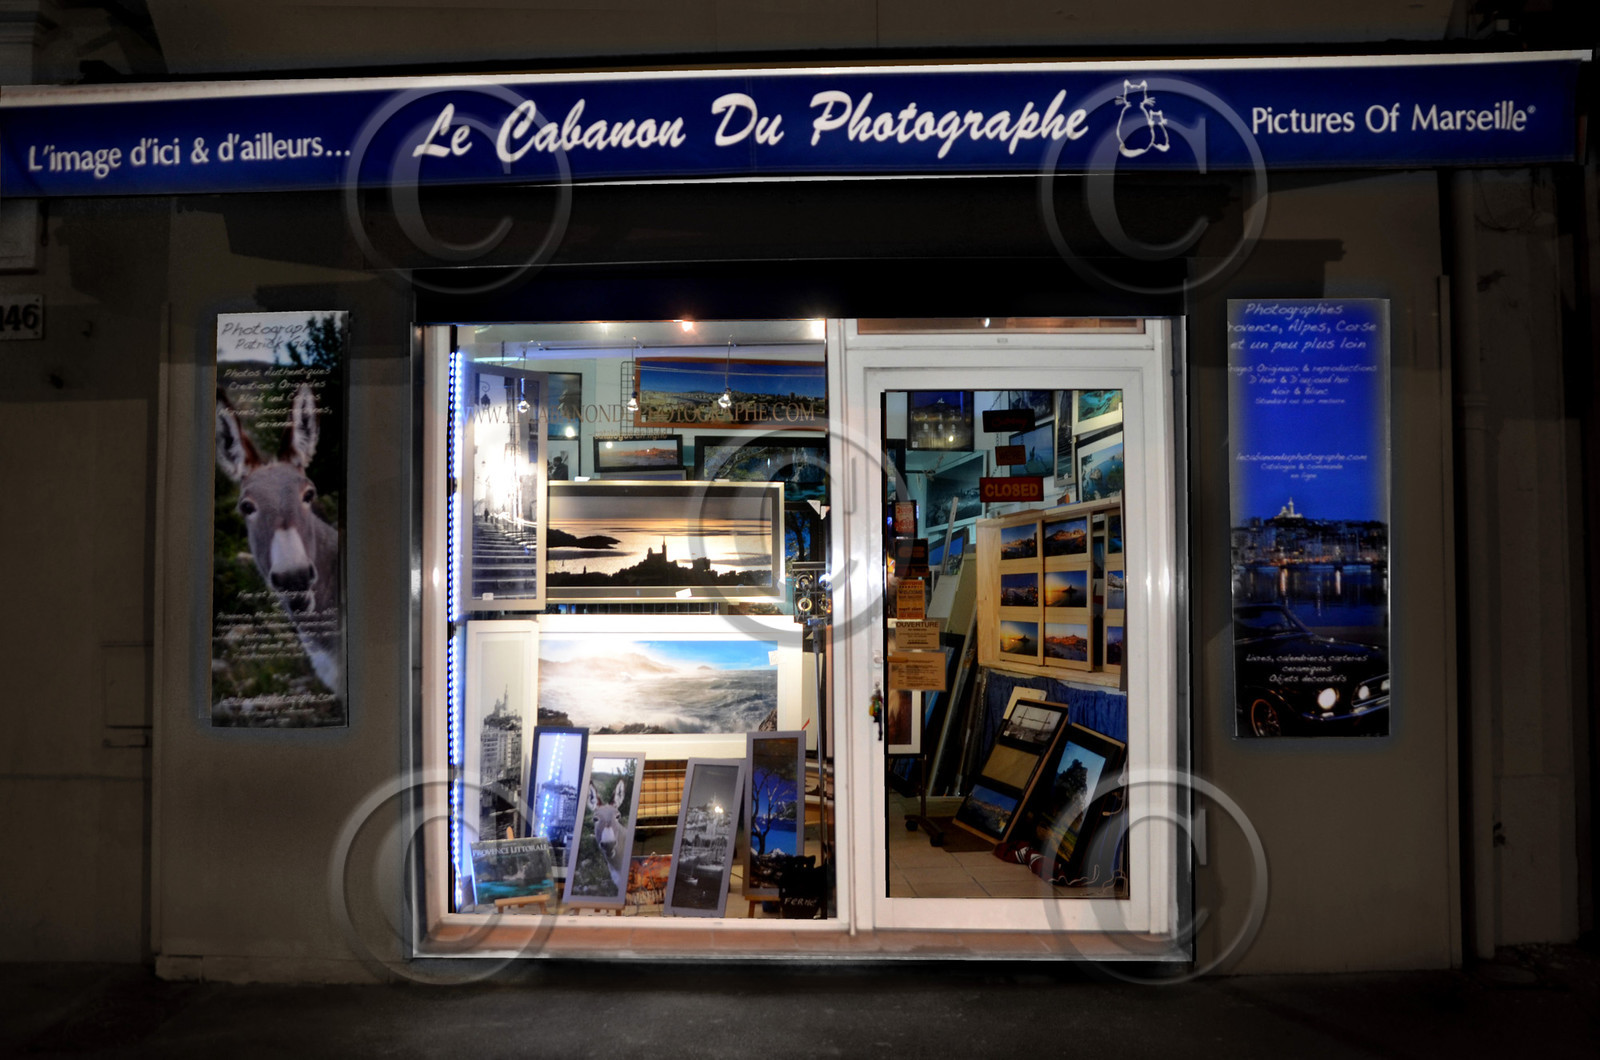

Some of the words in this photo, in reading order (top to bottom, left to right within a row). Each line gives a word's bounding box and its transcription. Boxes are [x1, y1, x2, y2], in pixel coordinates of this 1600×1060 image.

[412, 103, 473, 158] Le
[496, 98, 687, 163] Cabanon
[711, 92, 784, 147] Du
[809, 89, 1089, 159] Photographe
[1252, 104, 1355, 135] Pictures
[1365, 103, 1400, 133] Of
[29, 143, 122, 178] L'image
[130, 138, 181, 165] d'ici
[192, 136, 210, 163] &
[1336, 319, 1376, 333] Corse
[1250, 341, 1268, 350] un
[1271, 341, 1298, 353] peu
[1301, 337, 1335, 353] plus
[1340, 337, 1367, 350] loin
[984, 482, 1039, 498] CLOSED
